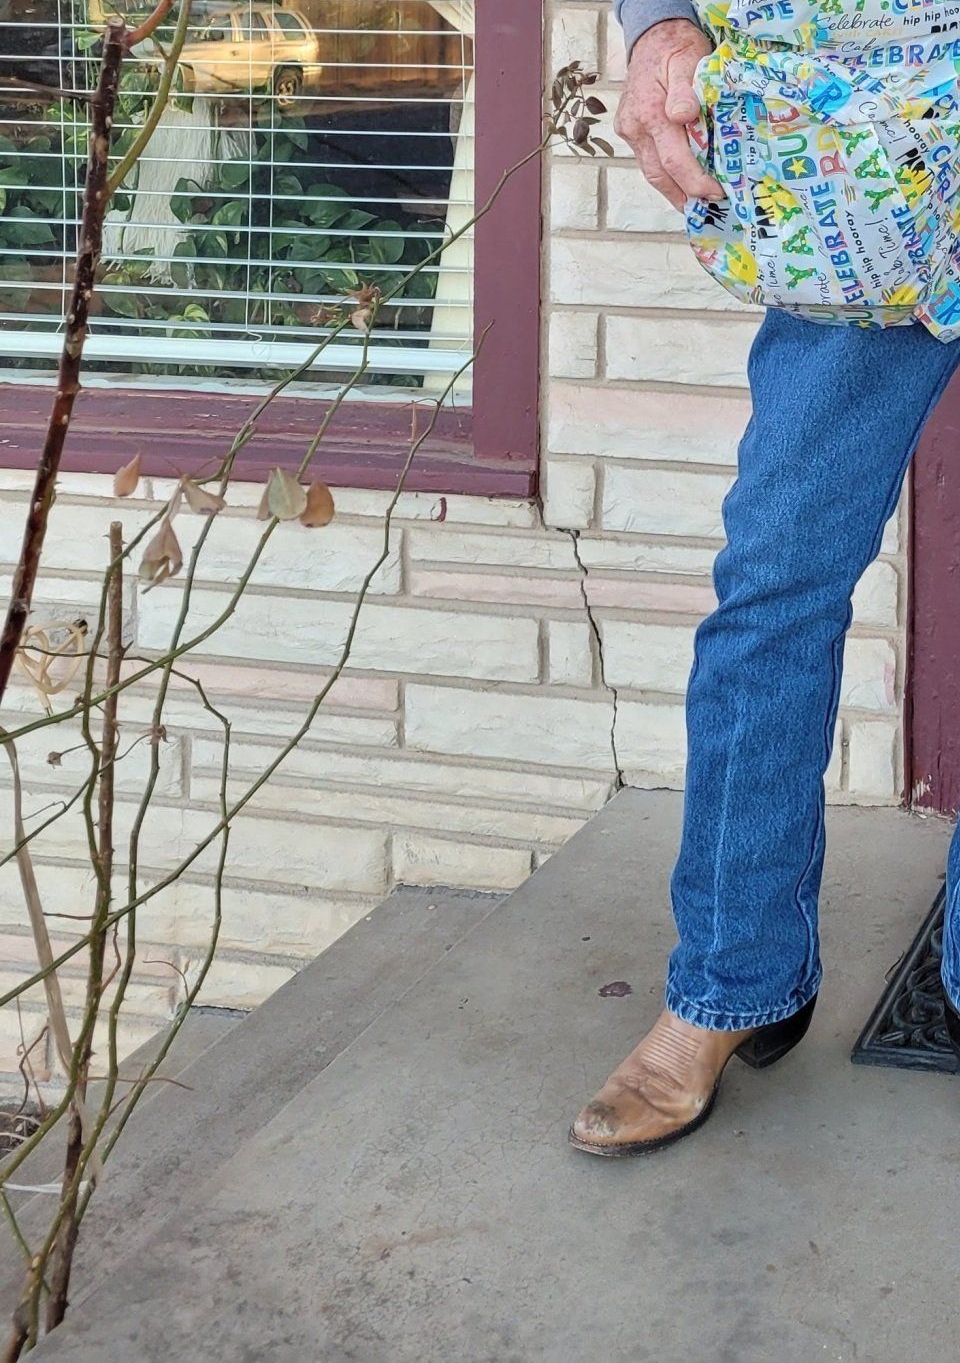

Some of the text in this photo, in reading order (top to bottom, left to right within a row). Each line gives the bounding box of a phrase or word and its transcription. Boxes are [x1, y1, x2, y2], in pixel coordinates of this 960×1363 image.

[903, 17, 920, 27] hip
[925, 11, 941, 23] hip
[903, 119, 930, 155] hooray
[747, 148, 756, 165] hip
[748, 177, 779, 239] PARTY
[845, 210, 883, 289] hip hip hooray
